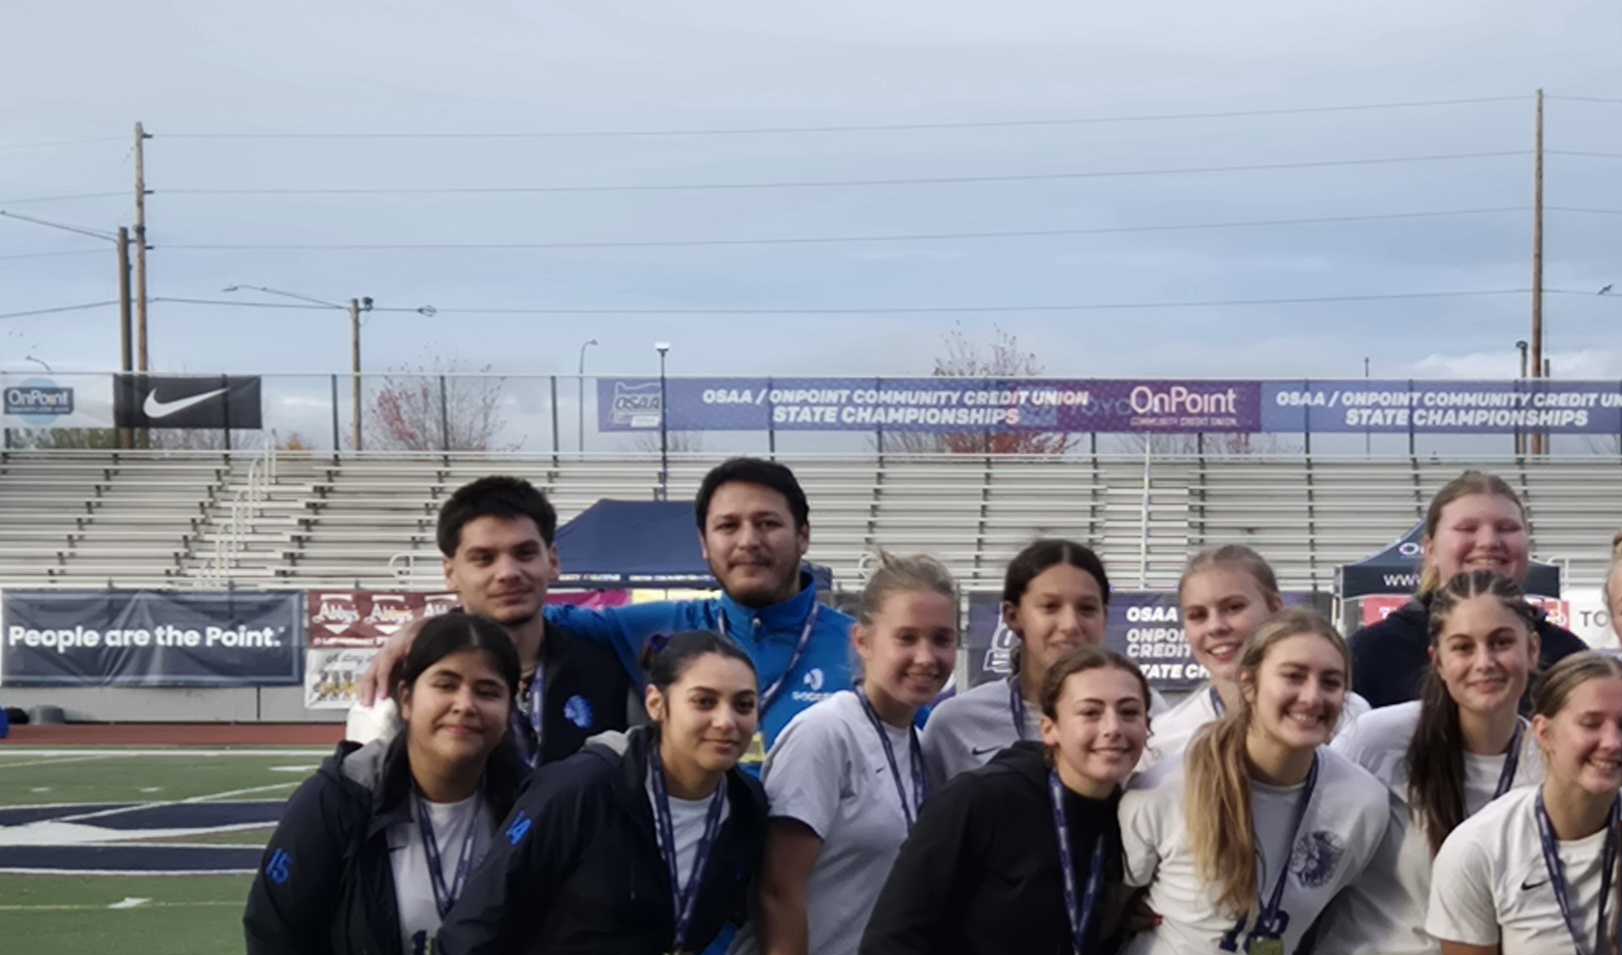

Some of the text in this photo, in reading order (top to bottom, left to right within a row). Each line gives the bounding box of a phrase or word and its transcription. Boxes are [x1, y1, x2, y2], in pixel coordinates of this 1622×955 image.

[702, 389, 1089, 406] OSAA / ONPOINT COMMUNITY CREDIT UNION
[1130, 386, 1237, 414] OnPoint
[1276, 391, 1325, 406] OSAA
[1328, 391, 1339, 407] /
[1342, 391, 1423, 407] ONPOINT
[1424, 391, 1531, 407] COMMUNITY
[1534, 392, 1599, 408] CREDIT
[772, 406, 1021, 425] STATE CHAMPIONSHIPS
[1345, 409, 1589, 427] STATE CHAMPIONSHIPS
[1126, 606, 1179, 622] OSAA
[9, 625, 99, 653] People
[105, 629, 150, 647] are
[154, 625, 201, 647] the
[1126, 628, 1186, 643] ONPOI
[1126, 643, 1191, 658] CREDIT
[1139, 663, 1184, 679] TATE
